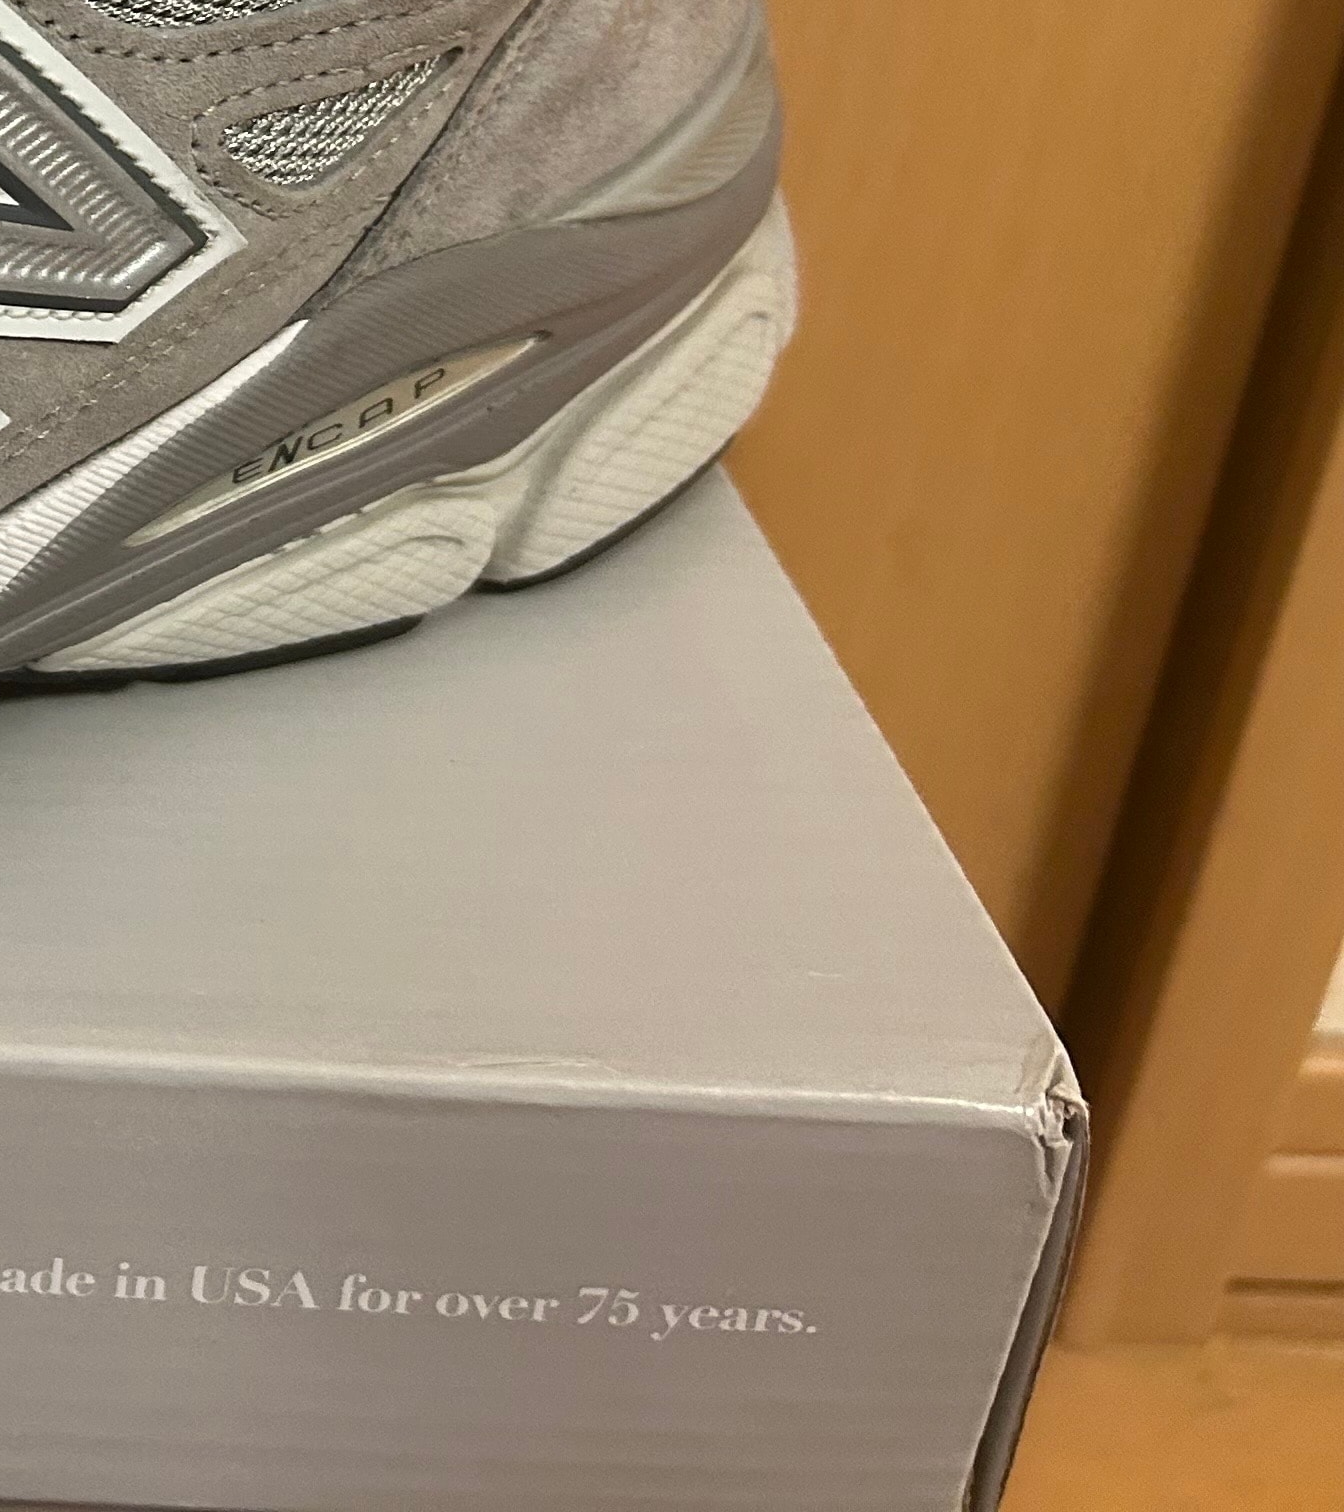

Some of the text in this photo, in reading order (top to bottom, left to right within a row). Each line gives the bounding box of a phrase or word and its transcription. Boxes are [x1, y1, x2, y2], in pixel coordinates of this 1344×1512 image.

[231, 367, 446, 484] ENCAP
[115, 1261, 167, 1302] in
[190, 1264, 321, 1310] USA
[335, 1272, 423, 1315] for
[435, 1291, 561, 1323] over
[576, 1286, 641, 1326] 75
[649, 1302, 818, 1342] years.
